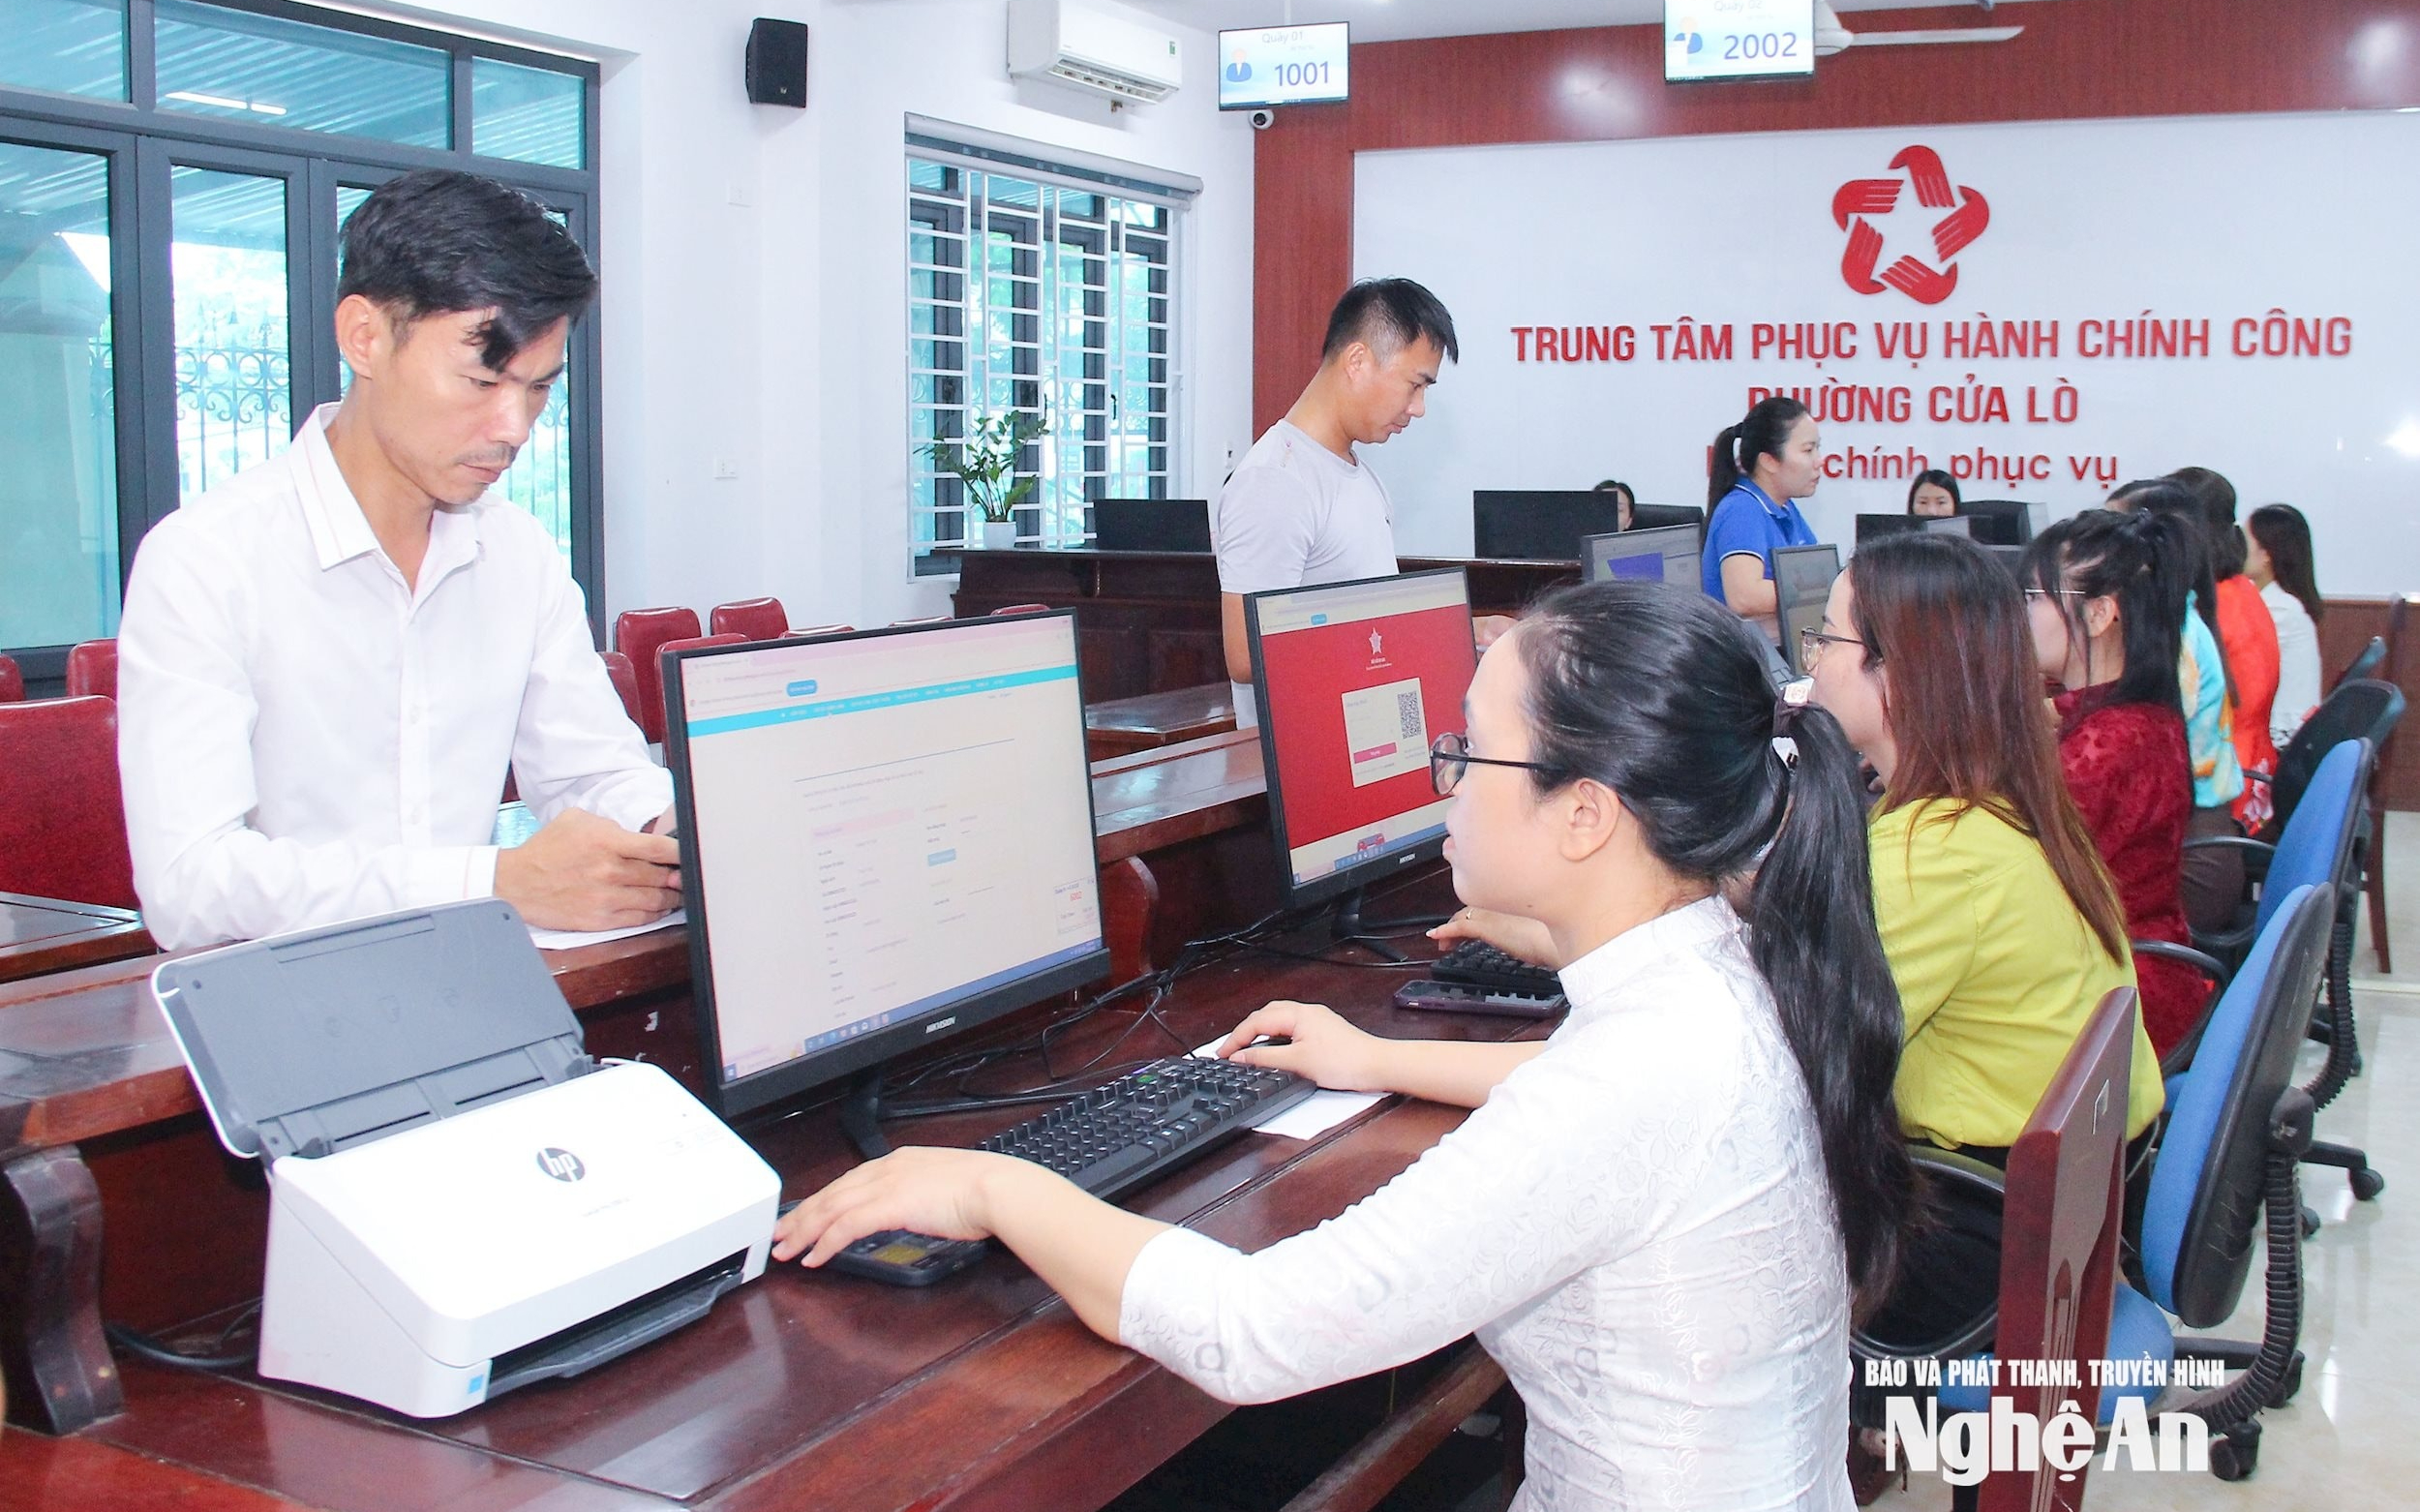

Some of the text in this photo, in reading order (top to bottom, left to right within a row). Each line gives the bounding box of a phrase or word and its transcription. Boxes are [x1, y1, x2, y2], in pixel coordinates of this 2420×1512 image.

[1291, 31, 1304, 42] 01
[1723, 32, 1798, 60] 2002
[1274, 61, 1329, 87] 1001
[1511, 309, 2353, 368] TRUNG TÂM PHỤC VỤ HÀNH CHÍNH CÔNG
[1927, 374, 2011, 424] CỬA
[2027, 377, 2079, 424] LÒ
[1821, 445, 2118, 490] chính phục vụ
[539, 1148, 579, 1181] hp
